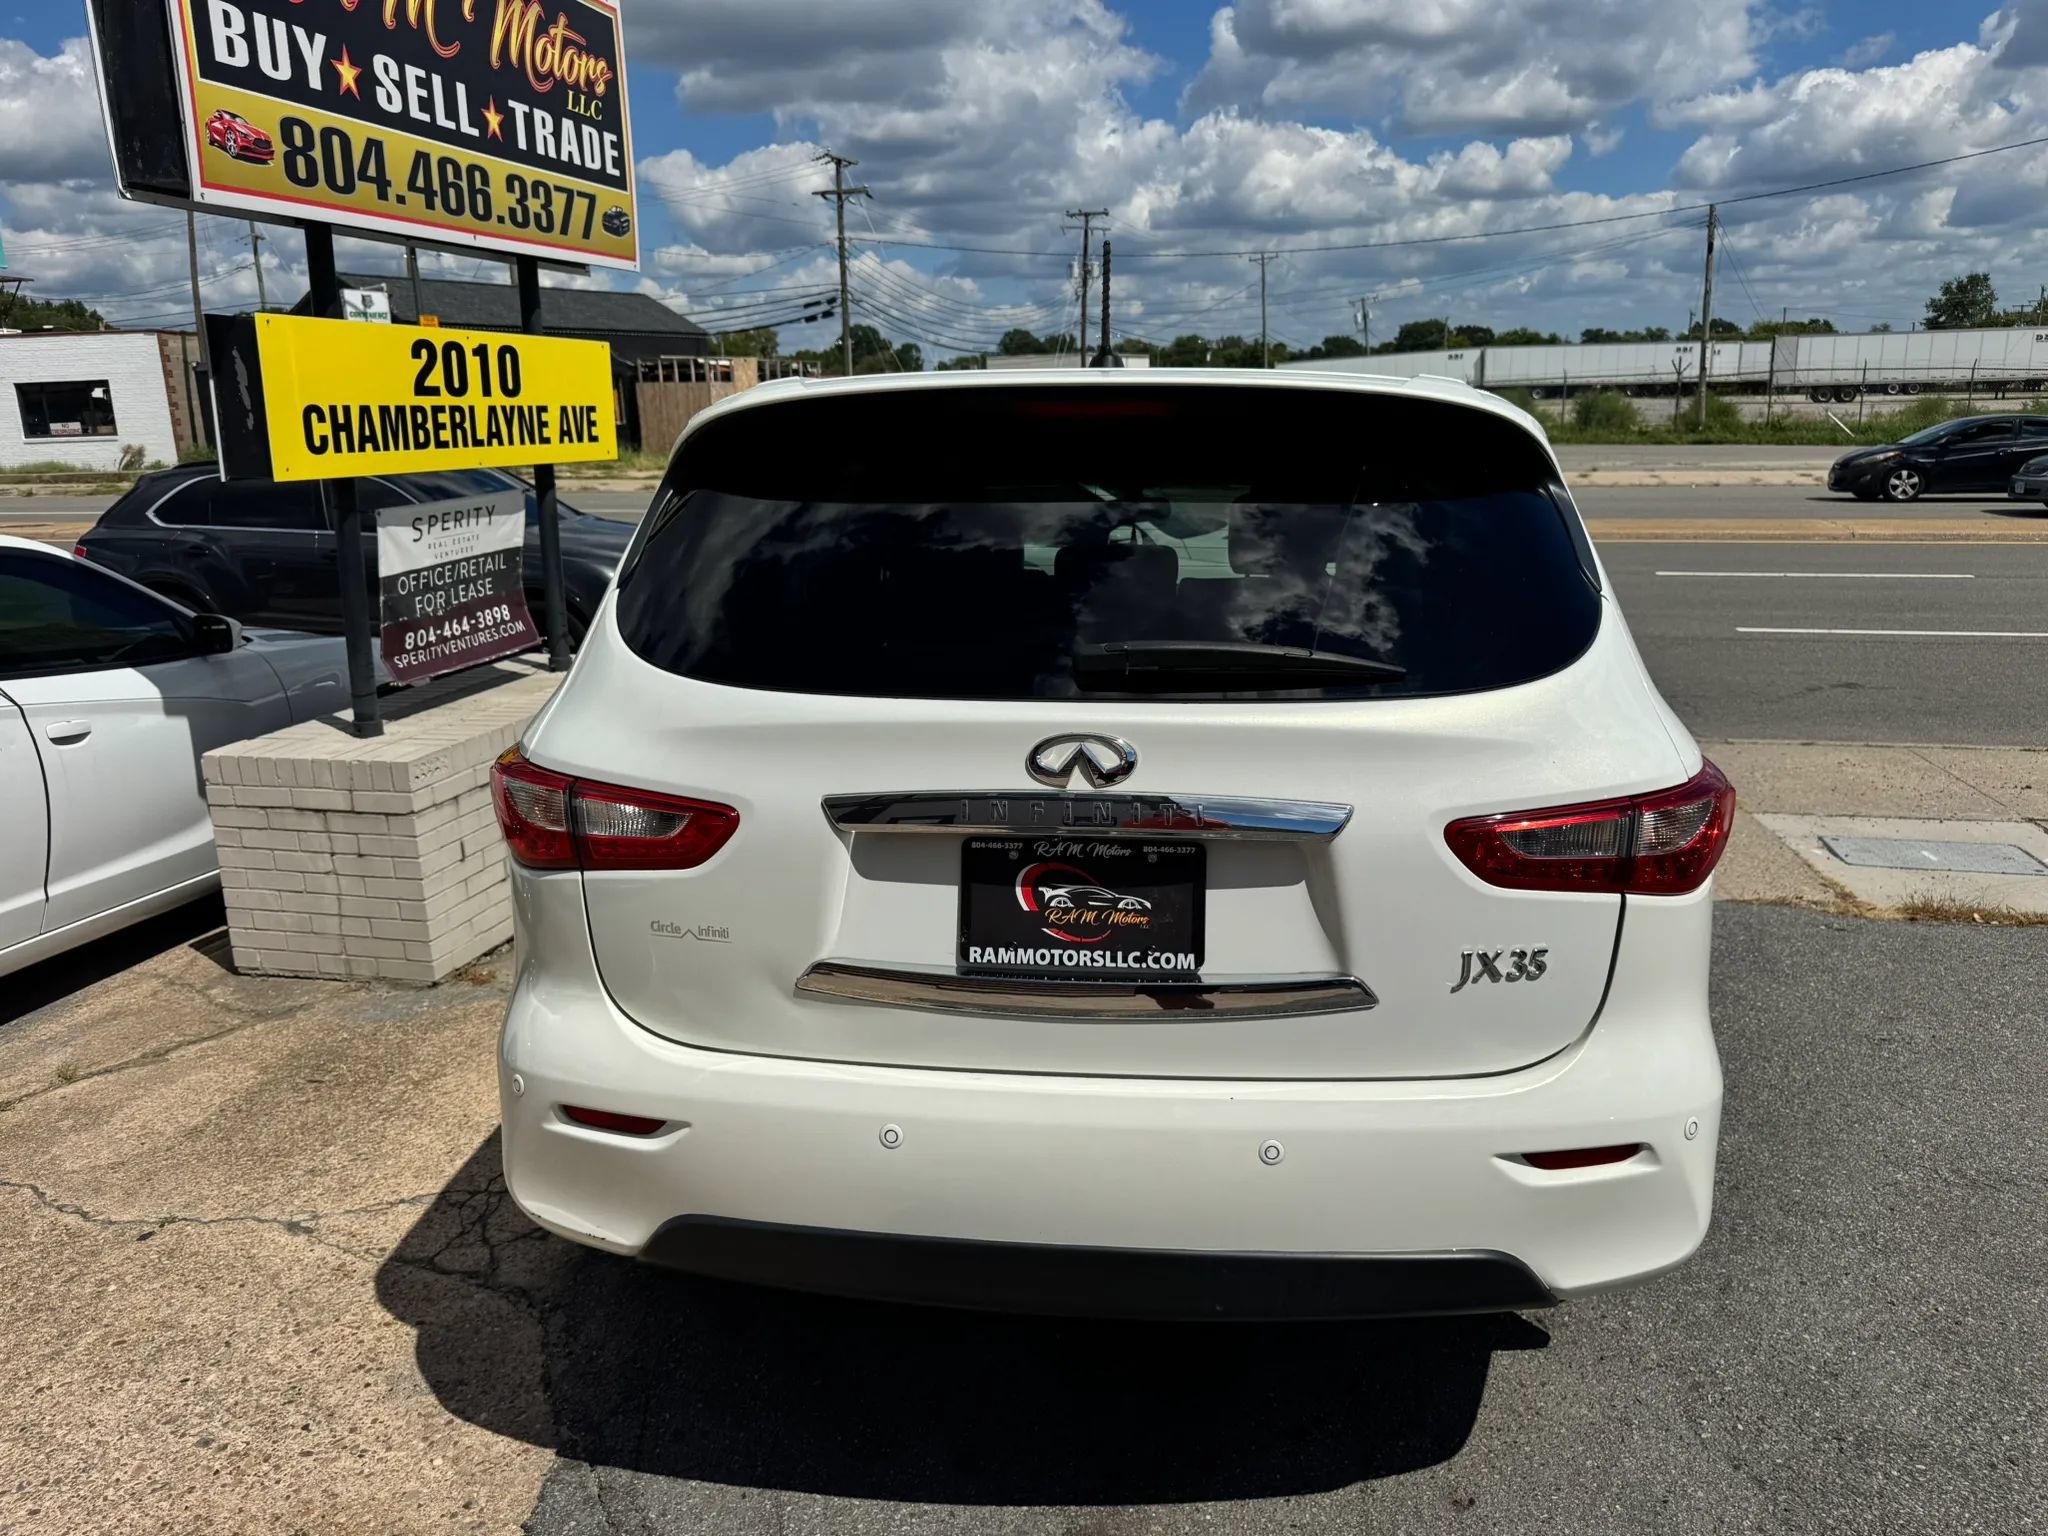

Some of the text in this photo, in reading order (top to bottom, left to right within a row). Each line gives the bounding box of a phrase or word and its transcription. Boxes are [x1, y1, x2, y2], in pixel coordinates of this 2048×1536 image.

[208, 0, 328, 92] BUY
[373, 53, 481, 138] SELL
[508, 100, 621, 178] TRADE
[566, 90, 603, 121] LLC
[279, 116, 597, 241] 804.466.3377
[411, 338, 522, 398] 2010
[302, 403, 600, 457] CHAMBERLAYNE AVE
[411, 504, 497, 543] SPERITY
[427, 533, 480, 550] REAL ESTATE
[434, 545, 474, 559] VENTURES
[397, 552, 507, 596] OFFICE/RETAIL
[415, 577, 494, 618] FOR LEASE
[393, 619, 526, 669] SPERITYVENTURES.COM
[404, 603, 511, 650] 804-464-3898
[959, 799, 1206, 828] INFINITI
[1033, 841, 1133, 859] RAM Motors
[650, 920, 730, 939] Circle Infiniti
[1044, 907, 1150, 927] RAM Motors
[968, 946, 1196, 971] RAMMOTORSLLC.COM
[1449, 947, 1549, 994] JX35
